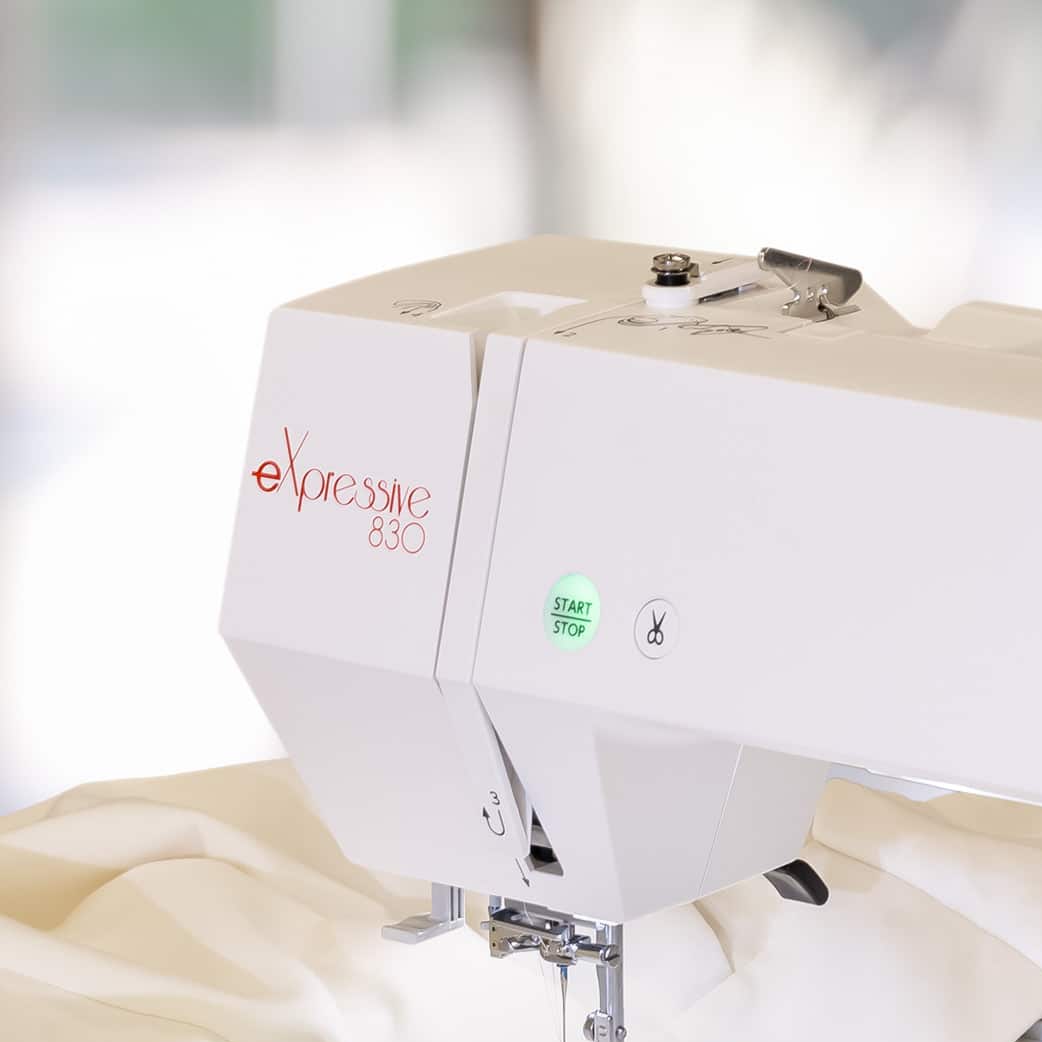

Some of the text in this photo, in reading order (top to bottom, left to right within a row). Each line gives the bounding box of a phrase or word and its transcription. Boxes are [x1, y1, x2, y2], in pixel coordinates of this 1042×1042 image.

[251, 427, 431, 519] eXpressive
[368, 516, 426, 554] 830
[553, 597, 592, 615] START
[552, 620, 586, 637] STOP
[489, 790, 501, 806] 3
